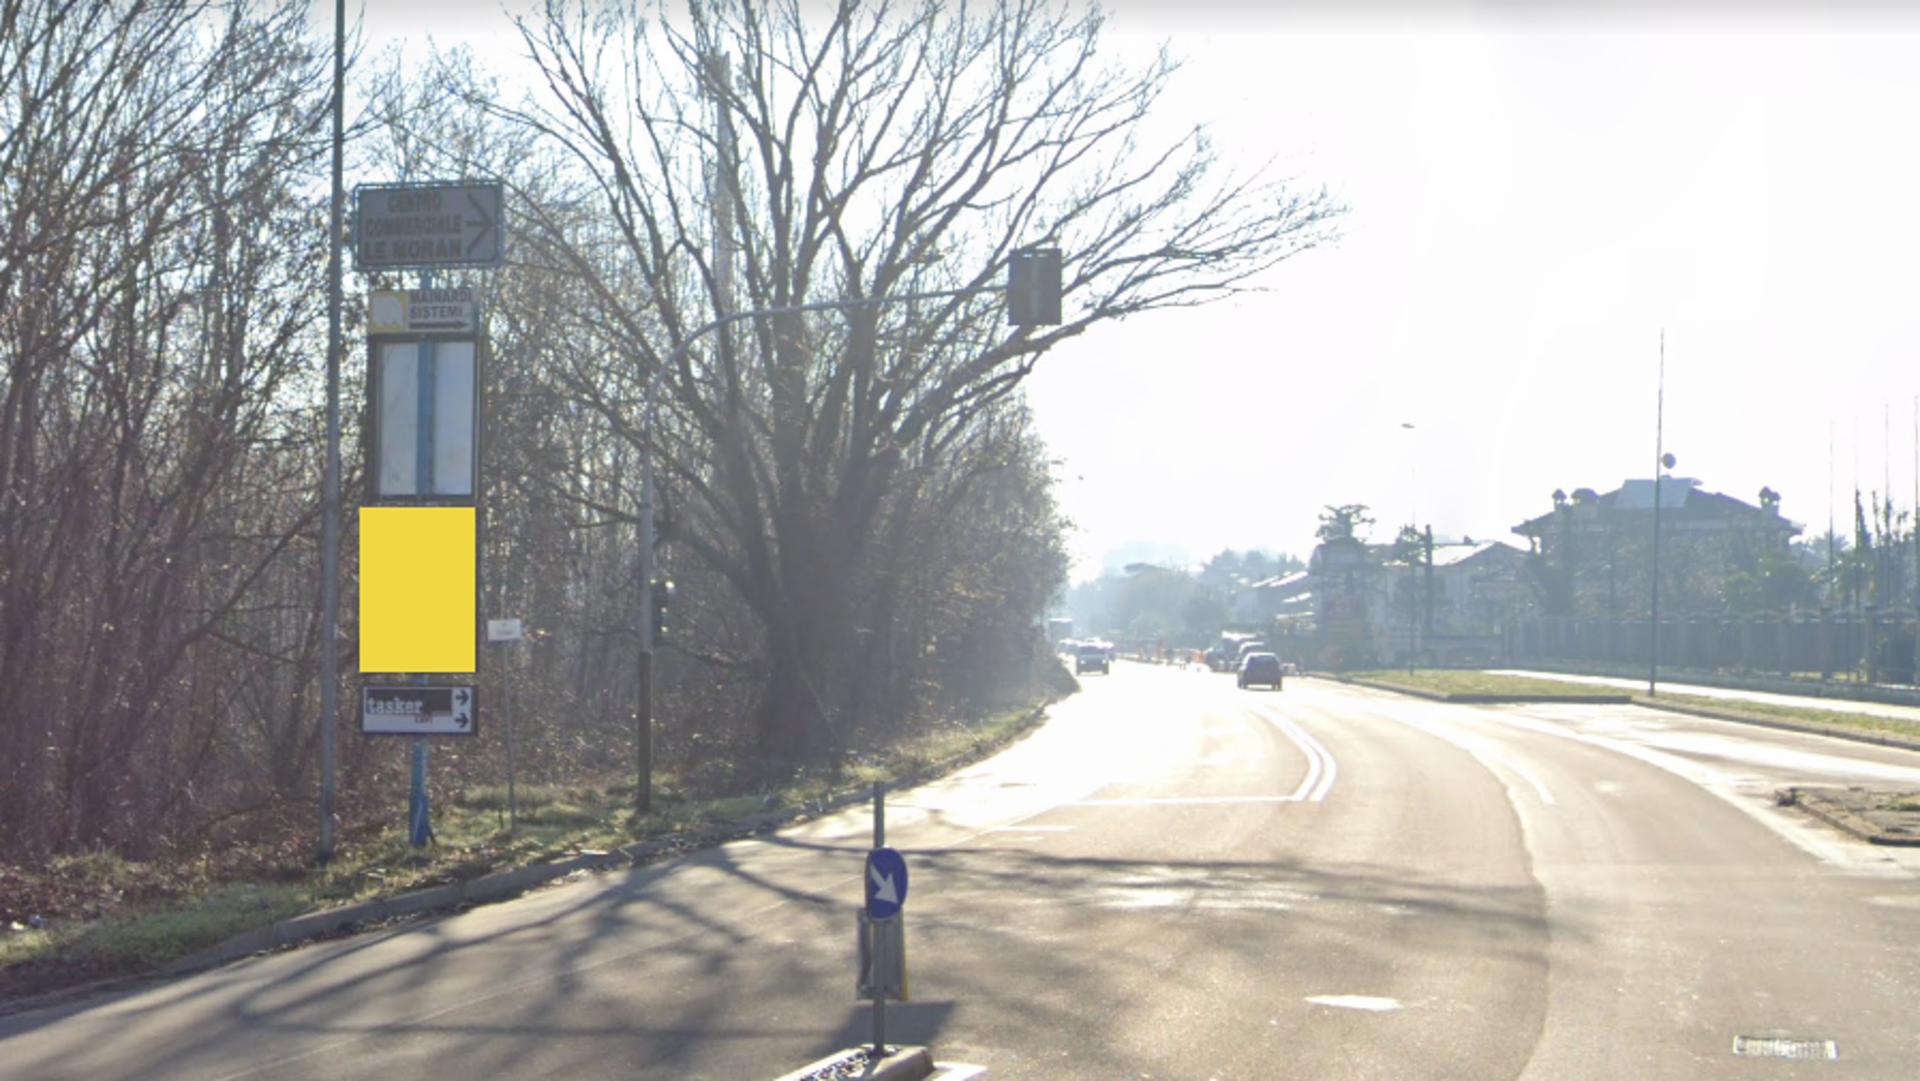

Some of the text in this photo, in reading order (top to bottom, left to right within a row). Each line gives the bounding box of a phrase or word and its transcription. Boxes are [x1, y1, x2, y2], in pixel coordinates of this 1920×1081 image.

[388, 192, 441, 213] CENTRO
[366, 214, 462, 236] COMMERCIALE
[364, 240, 386, 259] LE
[410, 289, 472, 303] MAINARDI
[409, 306, 463, 319] SISTEMI
[367, 697, 423, 714] tasker
